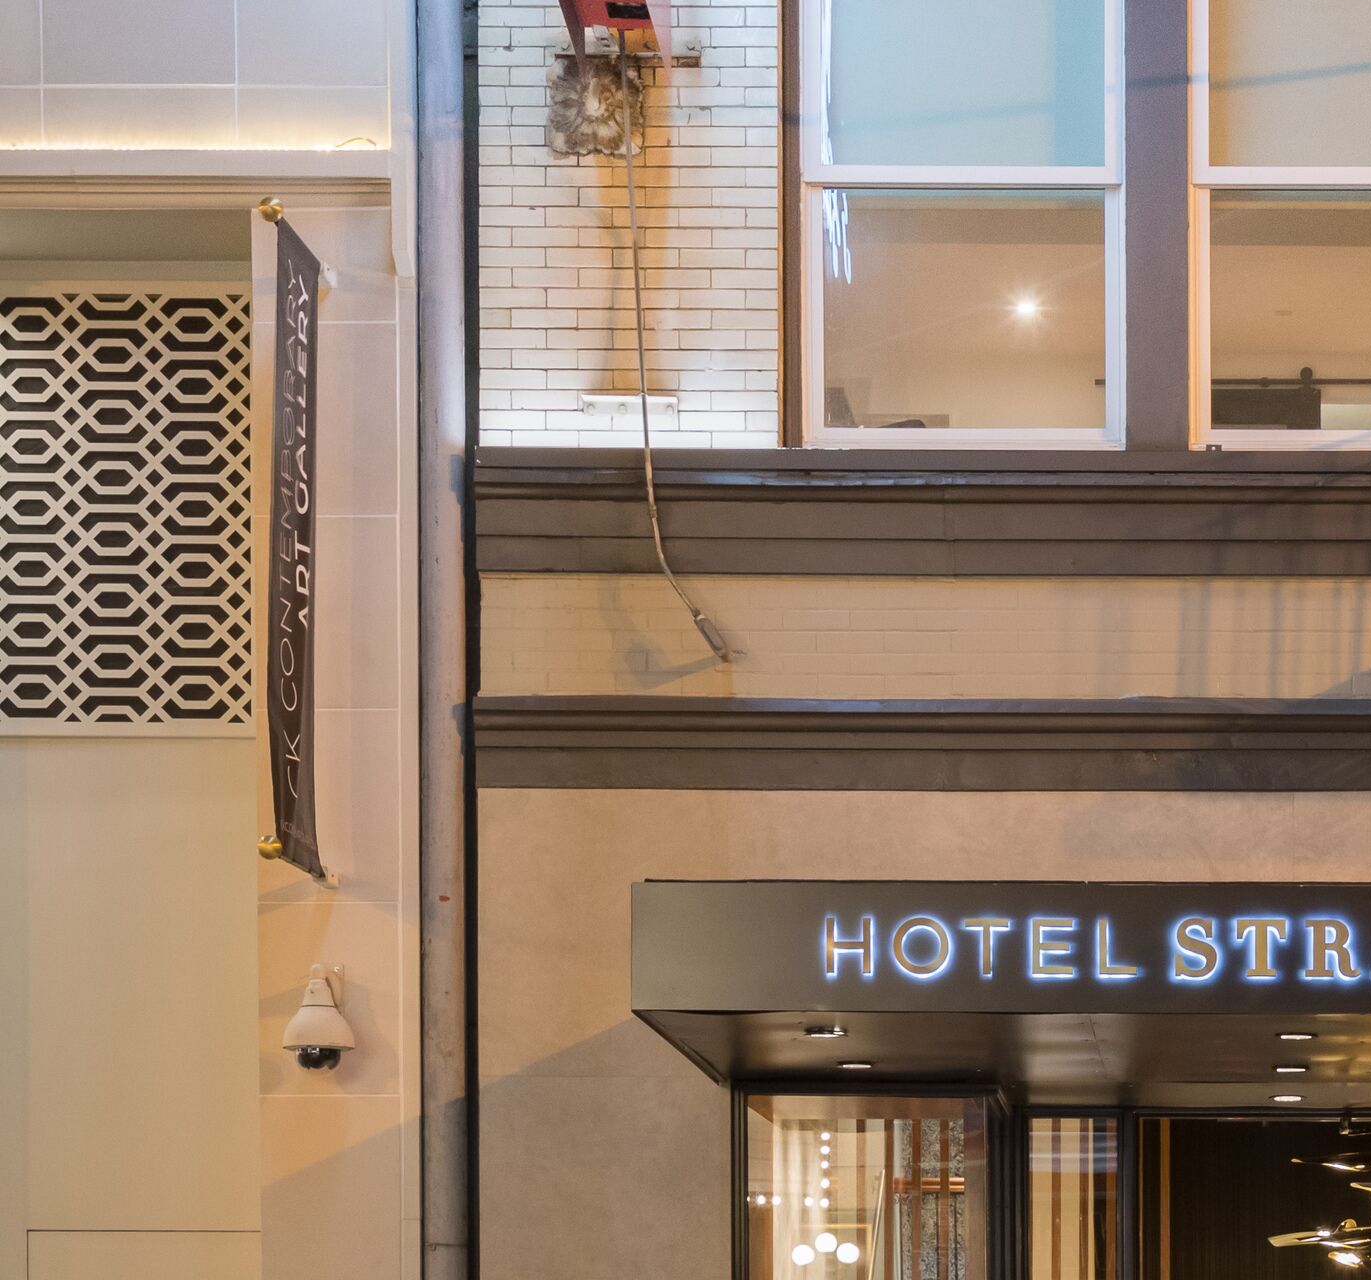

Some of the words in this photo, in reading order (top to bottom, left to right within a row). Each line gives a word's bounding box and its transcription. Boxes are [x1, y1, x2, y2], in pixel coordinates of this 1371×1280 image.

[295, 274, 309, 516] GALLERY
[279, 258, 298, 712] CONTEMPORARY
[295, 530, 311, 630] ART
[825, 917, 1138, 976] HOTEL
